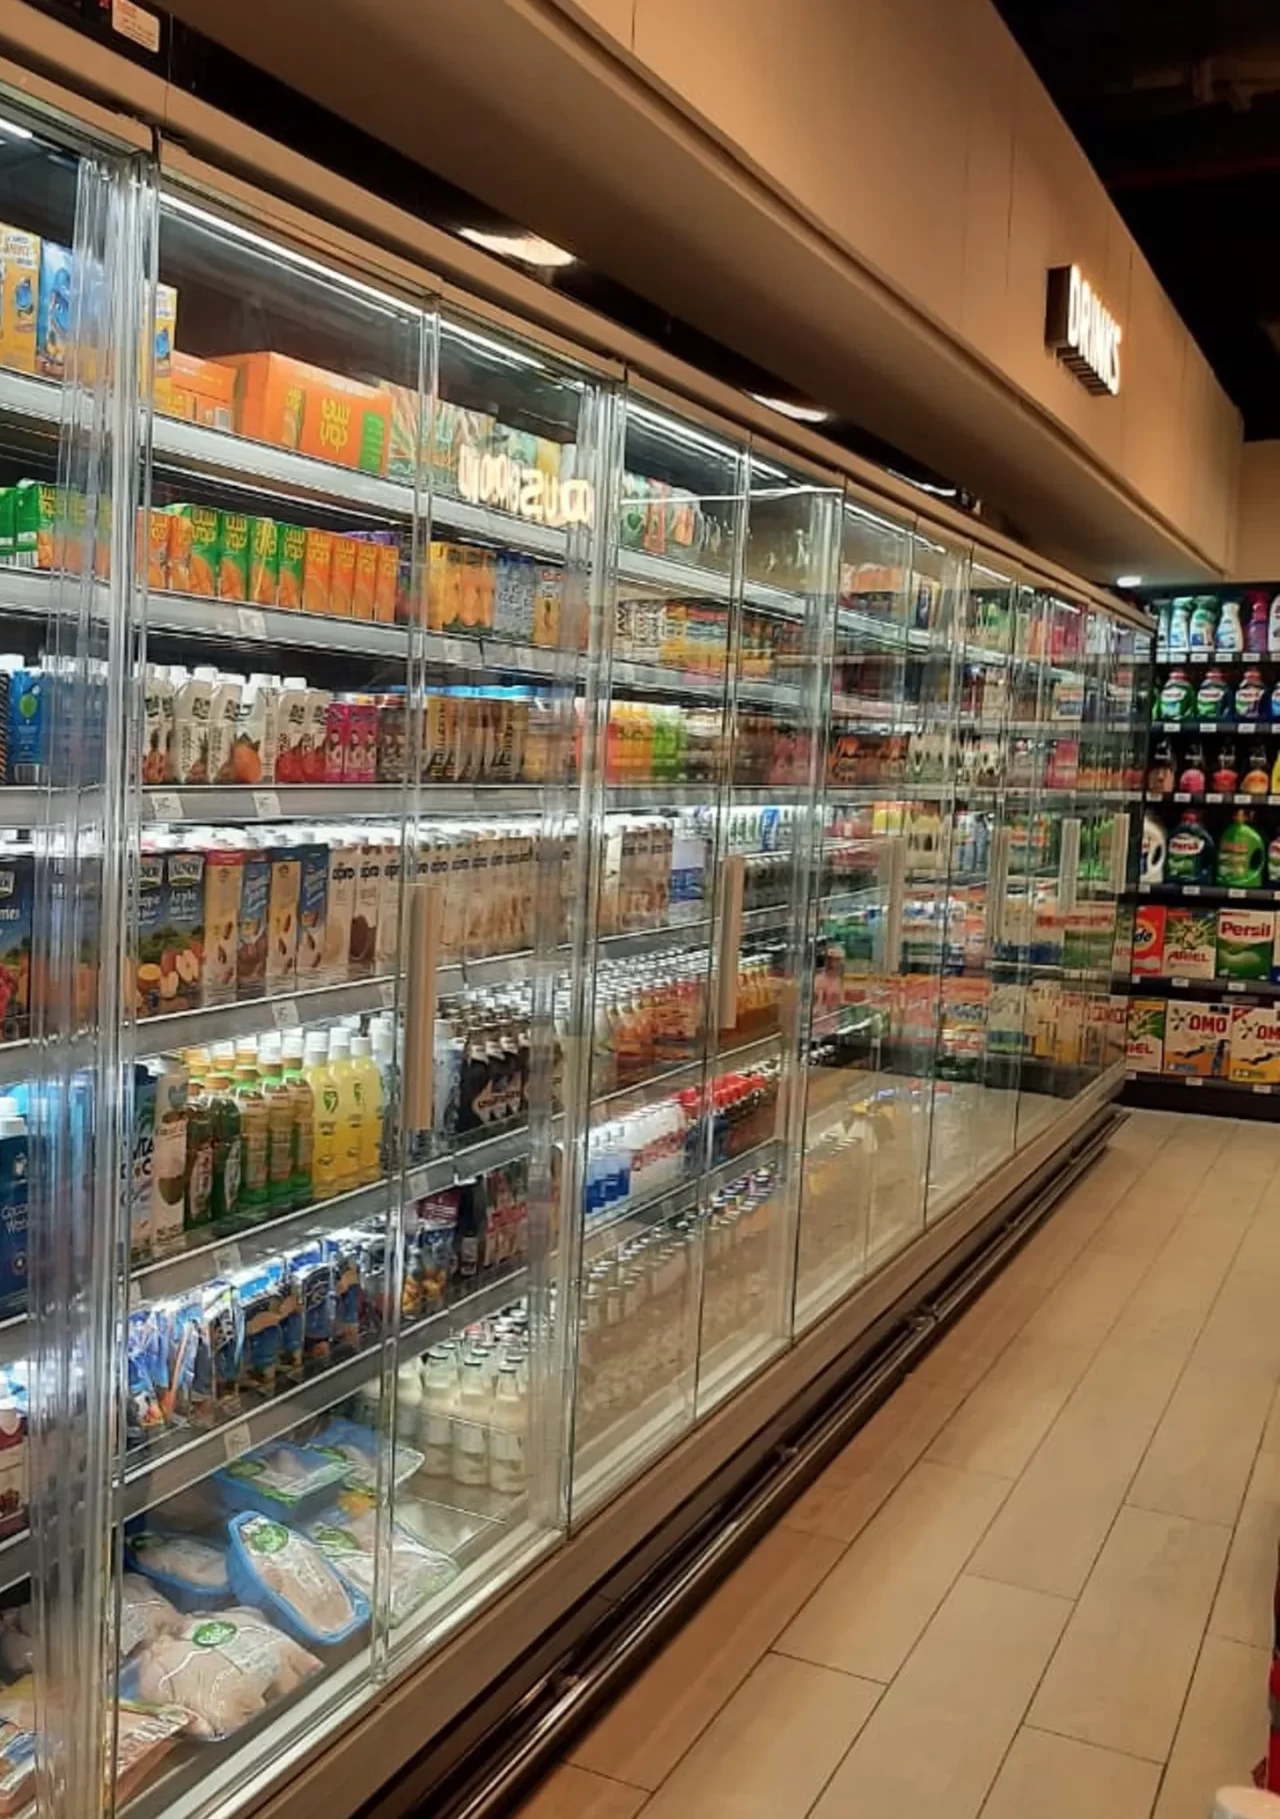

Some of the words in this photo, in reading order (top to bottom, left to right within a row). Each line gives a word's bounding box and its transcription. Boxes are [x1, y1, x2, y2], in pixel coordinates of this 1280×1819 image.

[1222, 921, 1271, 937] Persil
[1189, 1015, 1227, 1033] OMO
[1257, 1025, 1280, 1041] OM
